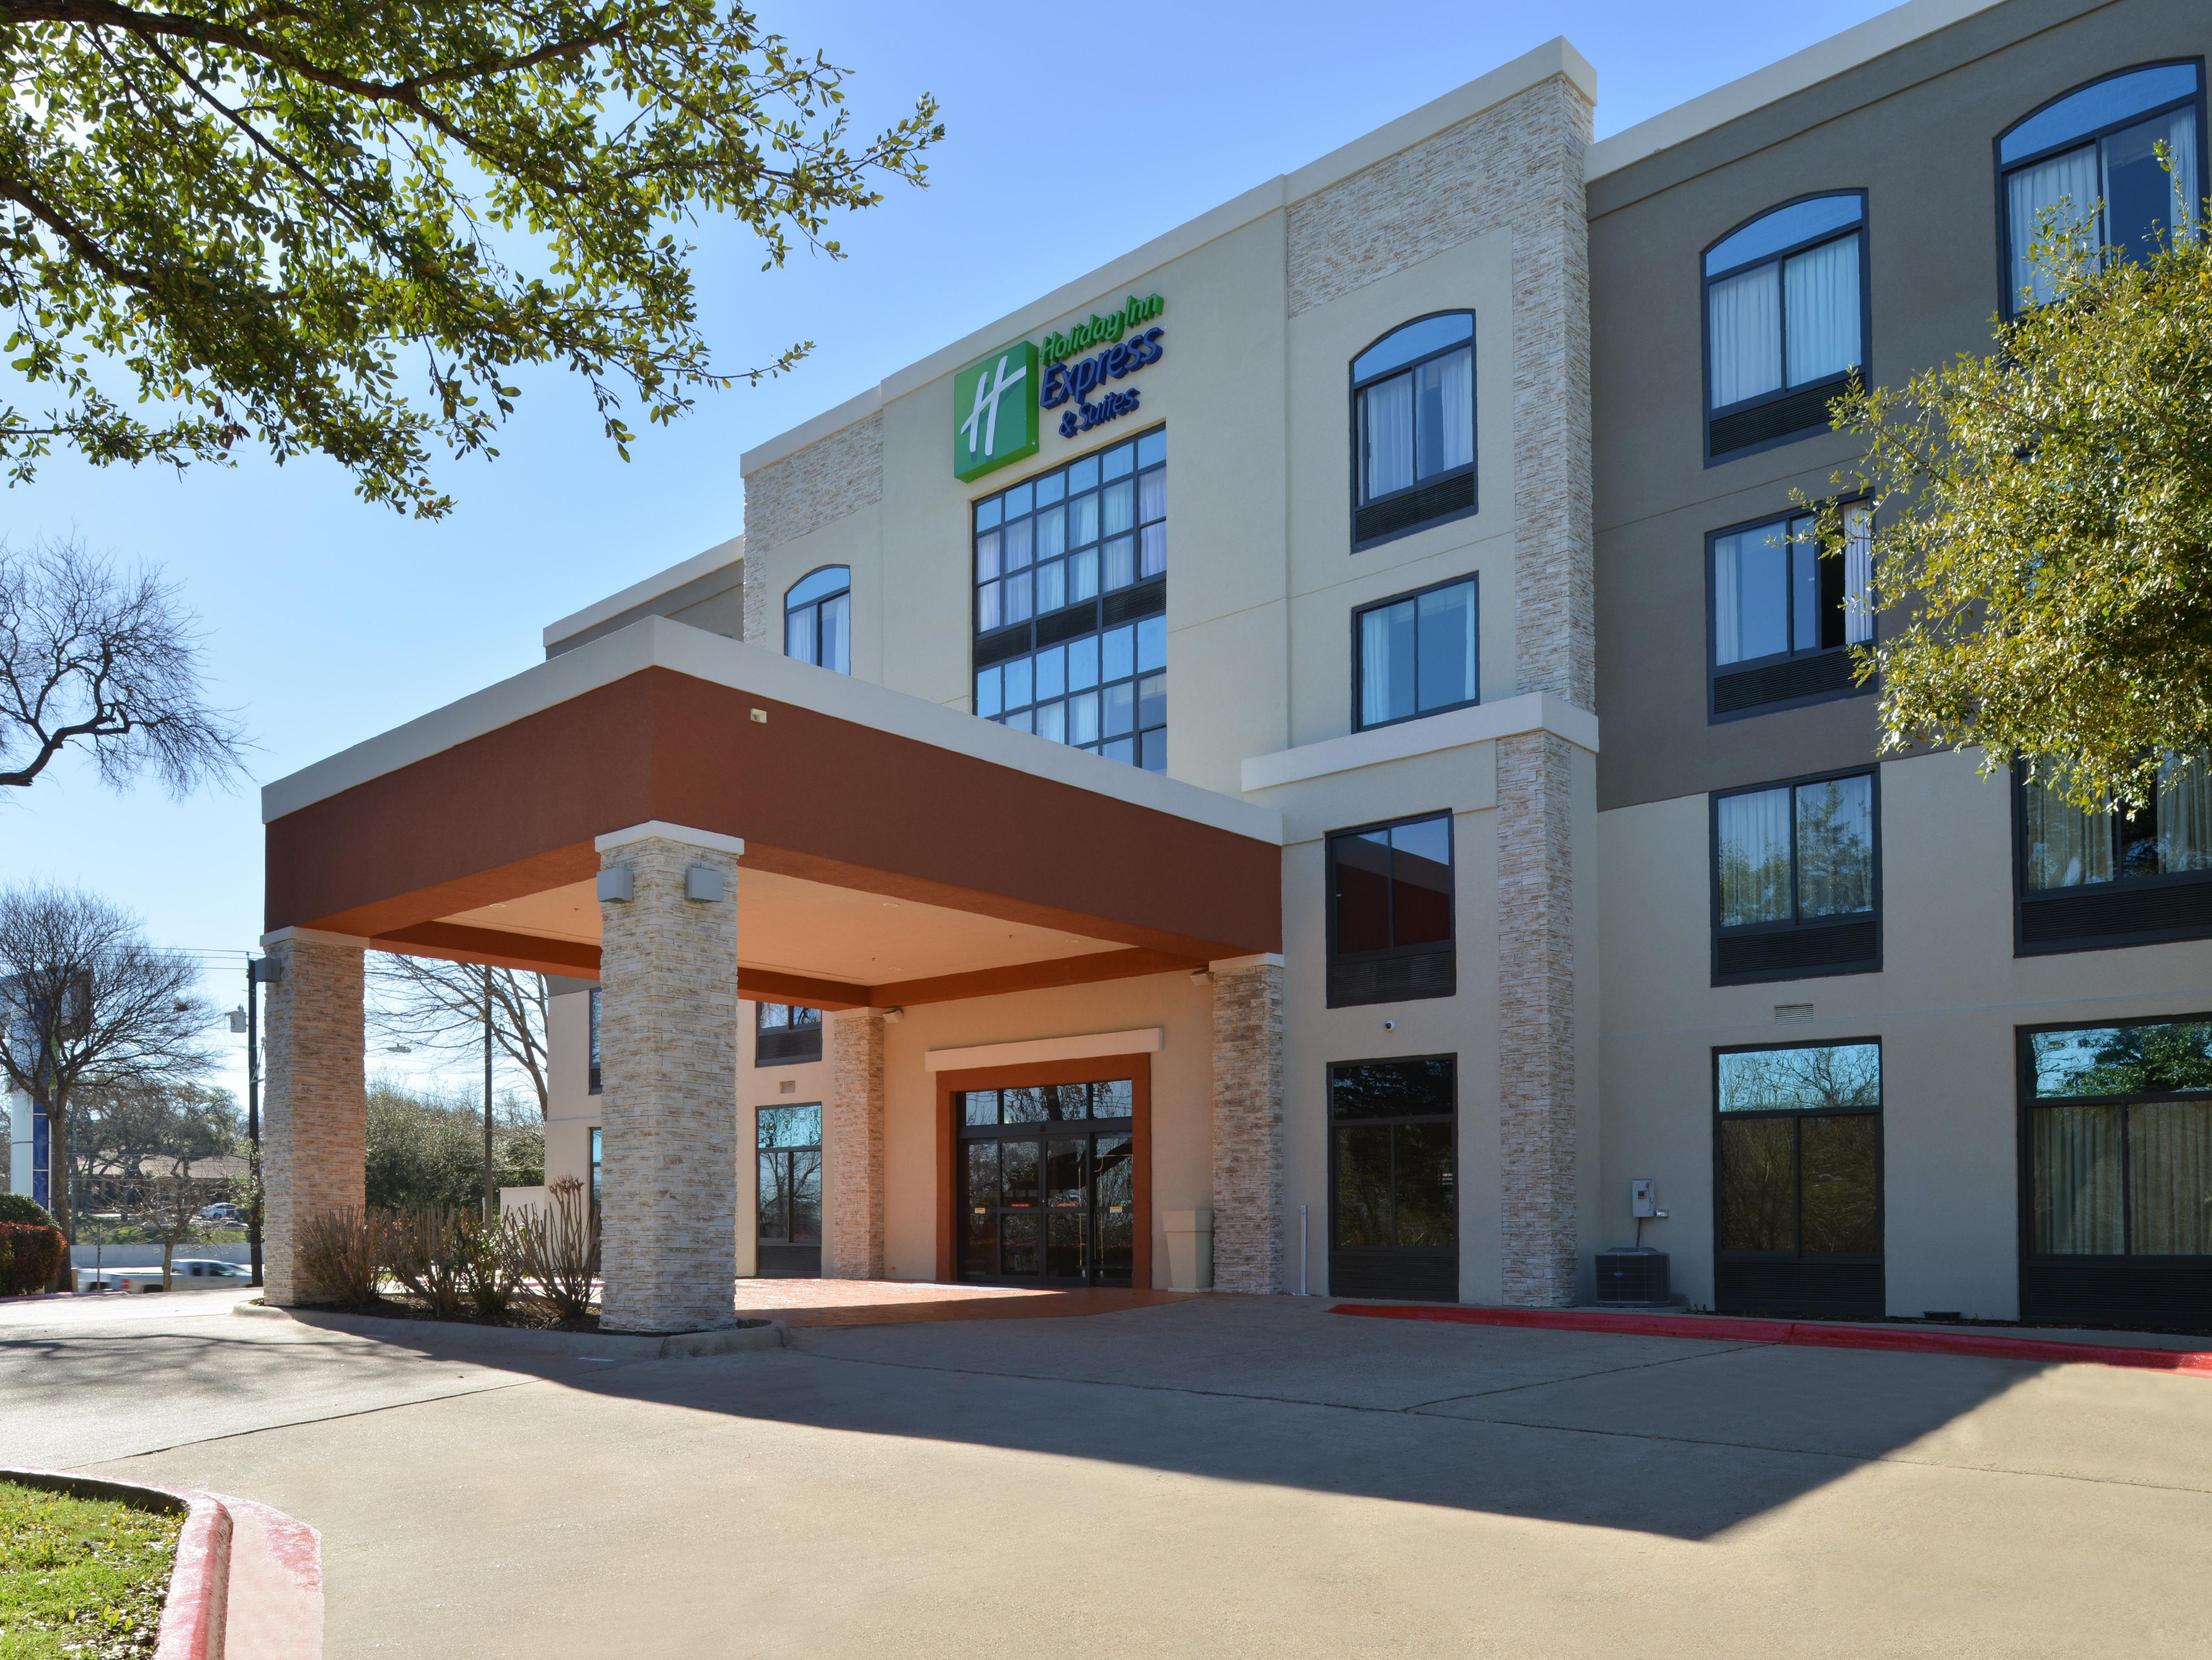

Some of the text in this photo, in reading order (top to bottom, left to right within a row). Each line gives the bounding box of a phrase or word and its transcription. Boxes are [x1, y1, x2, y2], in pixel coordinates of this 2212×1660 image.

[1040, 293, 1164, 367] Holiday Inn
[1040, 327, 1164, 409] Express
[1059, 388, 1140, 438] & Suites
